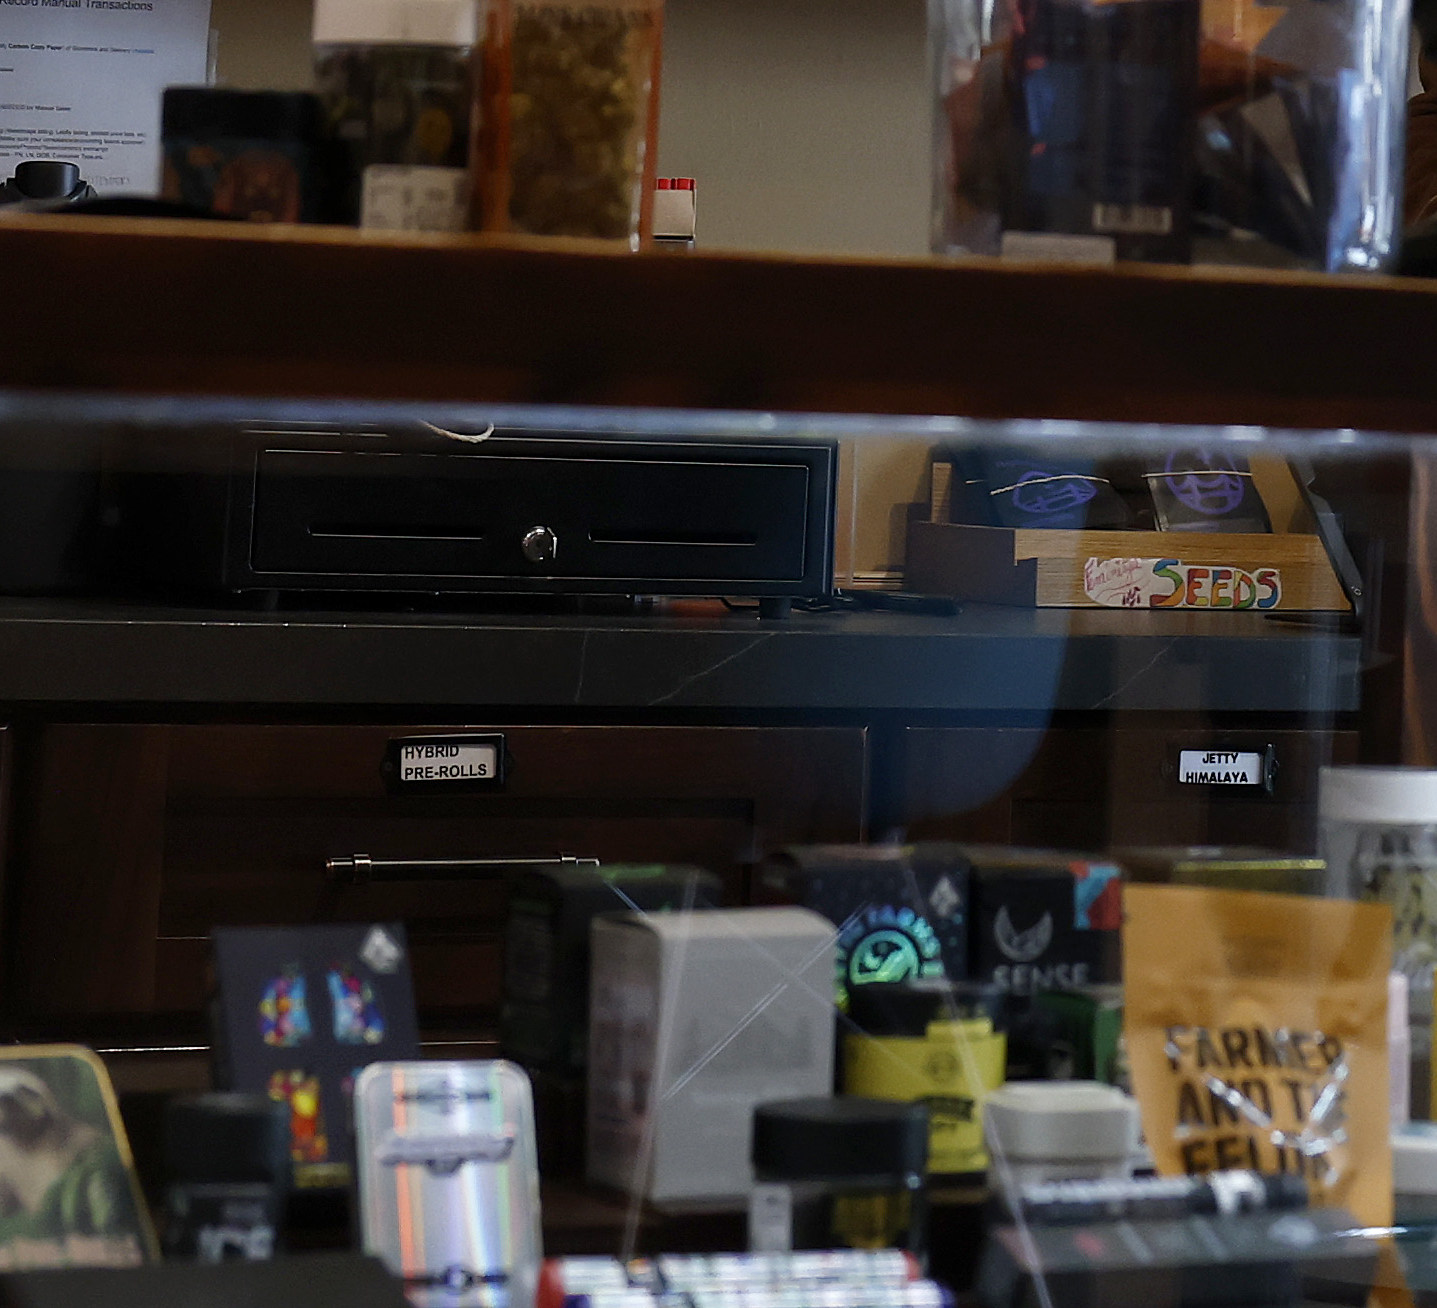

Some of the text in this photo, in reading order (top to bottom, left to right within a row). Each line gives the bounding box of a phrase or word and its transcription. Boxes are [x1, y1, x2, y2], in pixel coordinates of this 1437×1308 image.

[1150, 558, 1279, 609] SEEDS
[405, 746, 459, 759] HYBRID
[1202, 753, 1238, 763] JETTY
[405, 764, 487, 779] PRE-ROLLS
[1186, 772, 1248, 783] HIMALAYA
